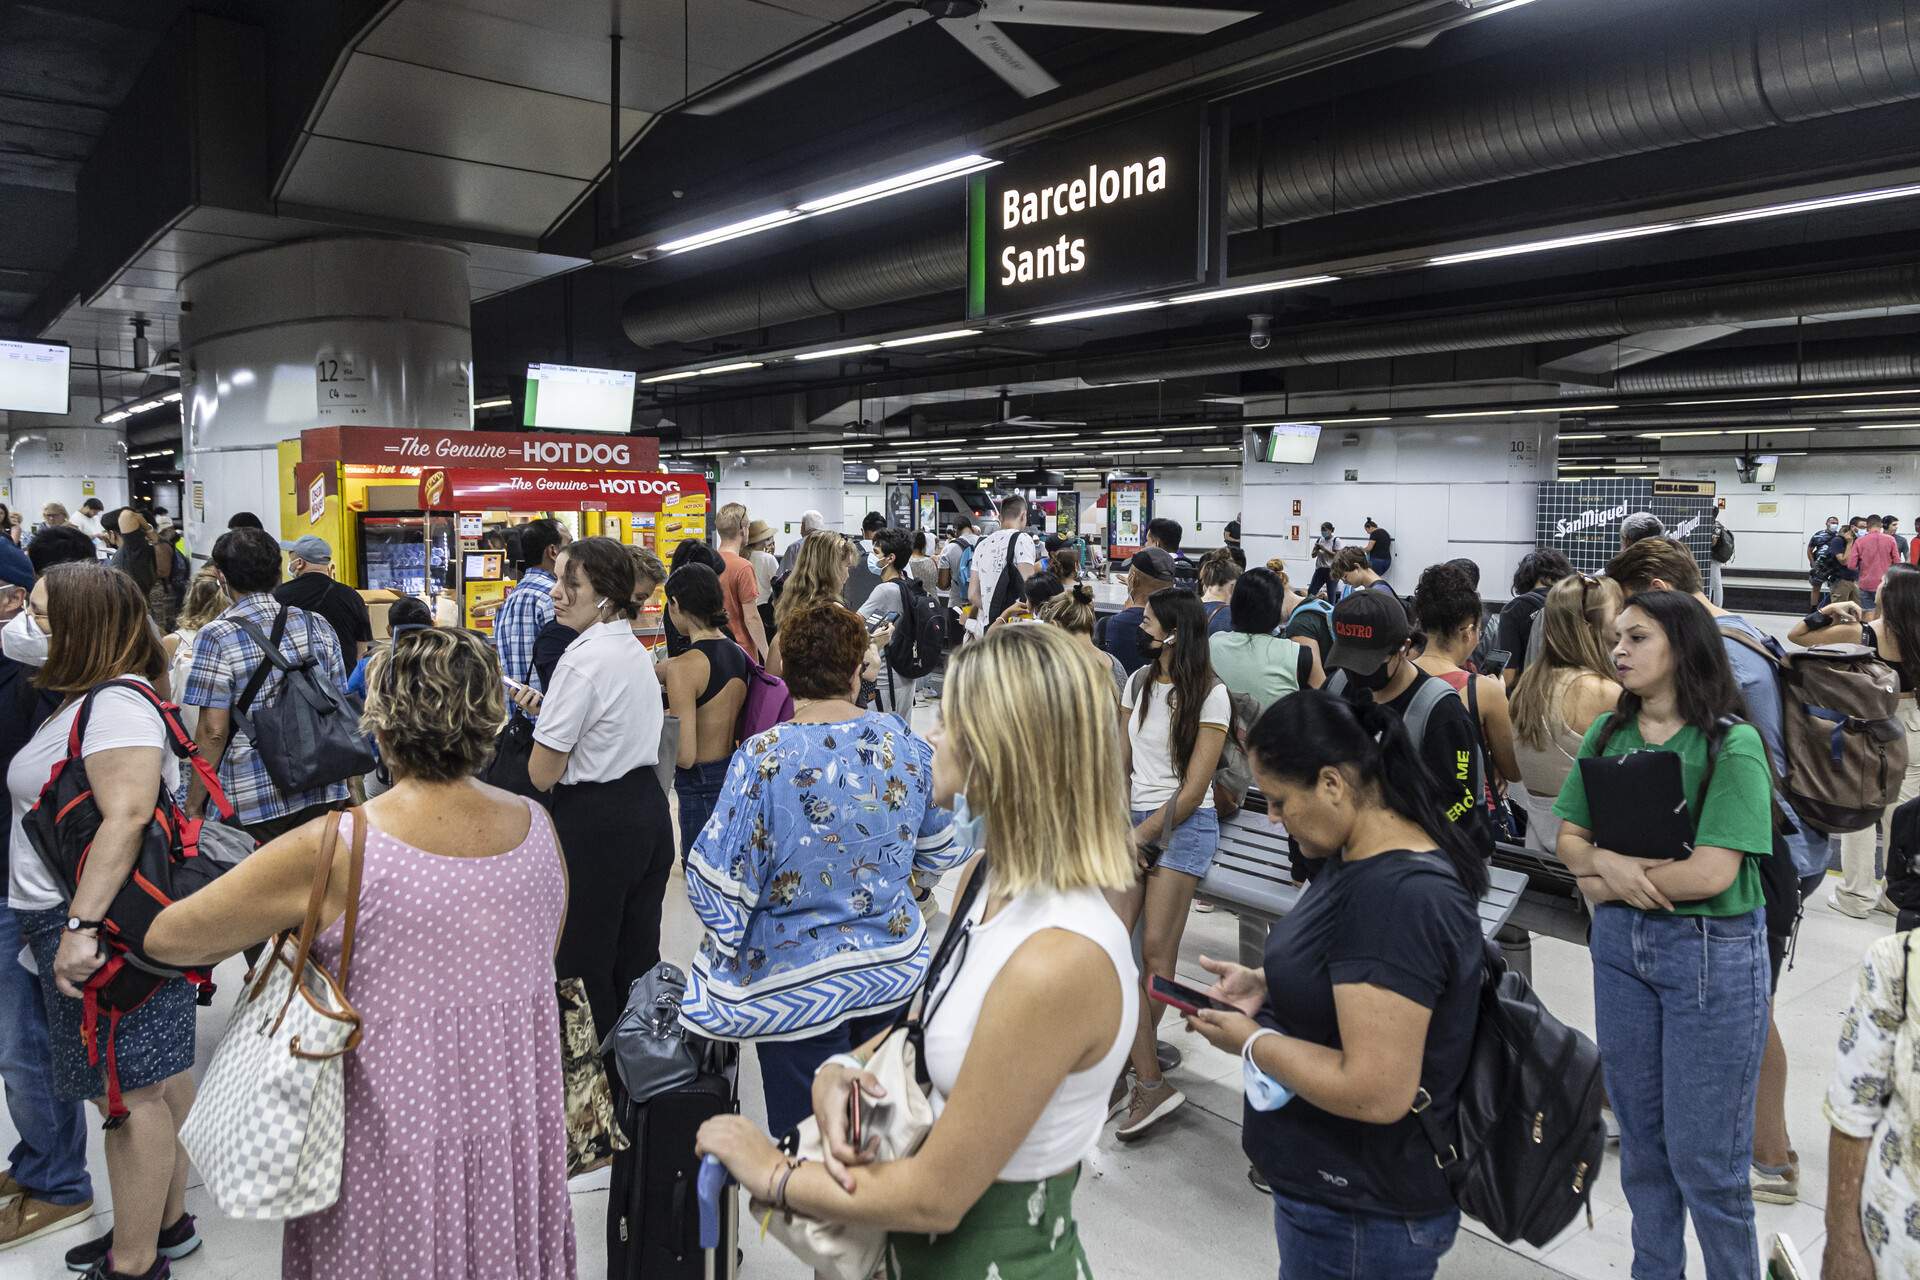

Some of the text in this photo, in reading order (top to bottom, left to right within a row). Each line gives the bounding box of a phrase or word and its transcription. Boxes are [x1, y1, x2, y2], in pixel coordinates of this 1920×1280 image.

[1003, 156, 1167, 230] Barcelona
[1002, 234, 1086, 286] Sants
[319, 360, 339, 383] 12
[329, 388, 340, 399] C4
[54, 442, 64, 452] 12
[400, 436, 631, 465] The Genuine HOT DOG
[1510, 440, 1525, 453] 10
[705, 471, 714, 480] 10
[510, 476, 681, 495] The Genuine HOT DOG
[1335, 621, 1374, 639] CASTRO
[1456, 750, 1470, 780] ME
